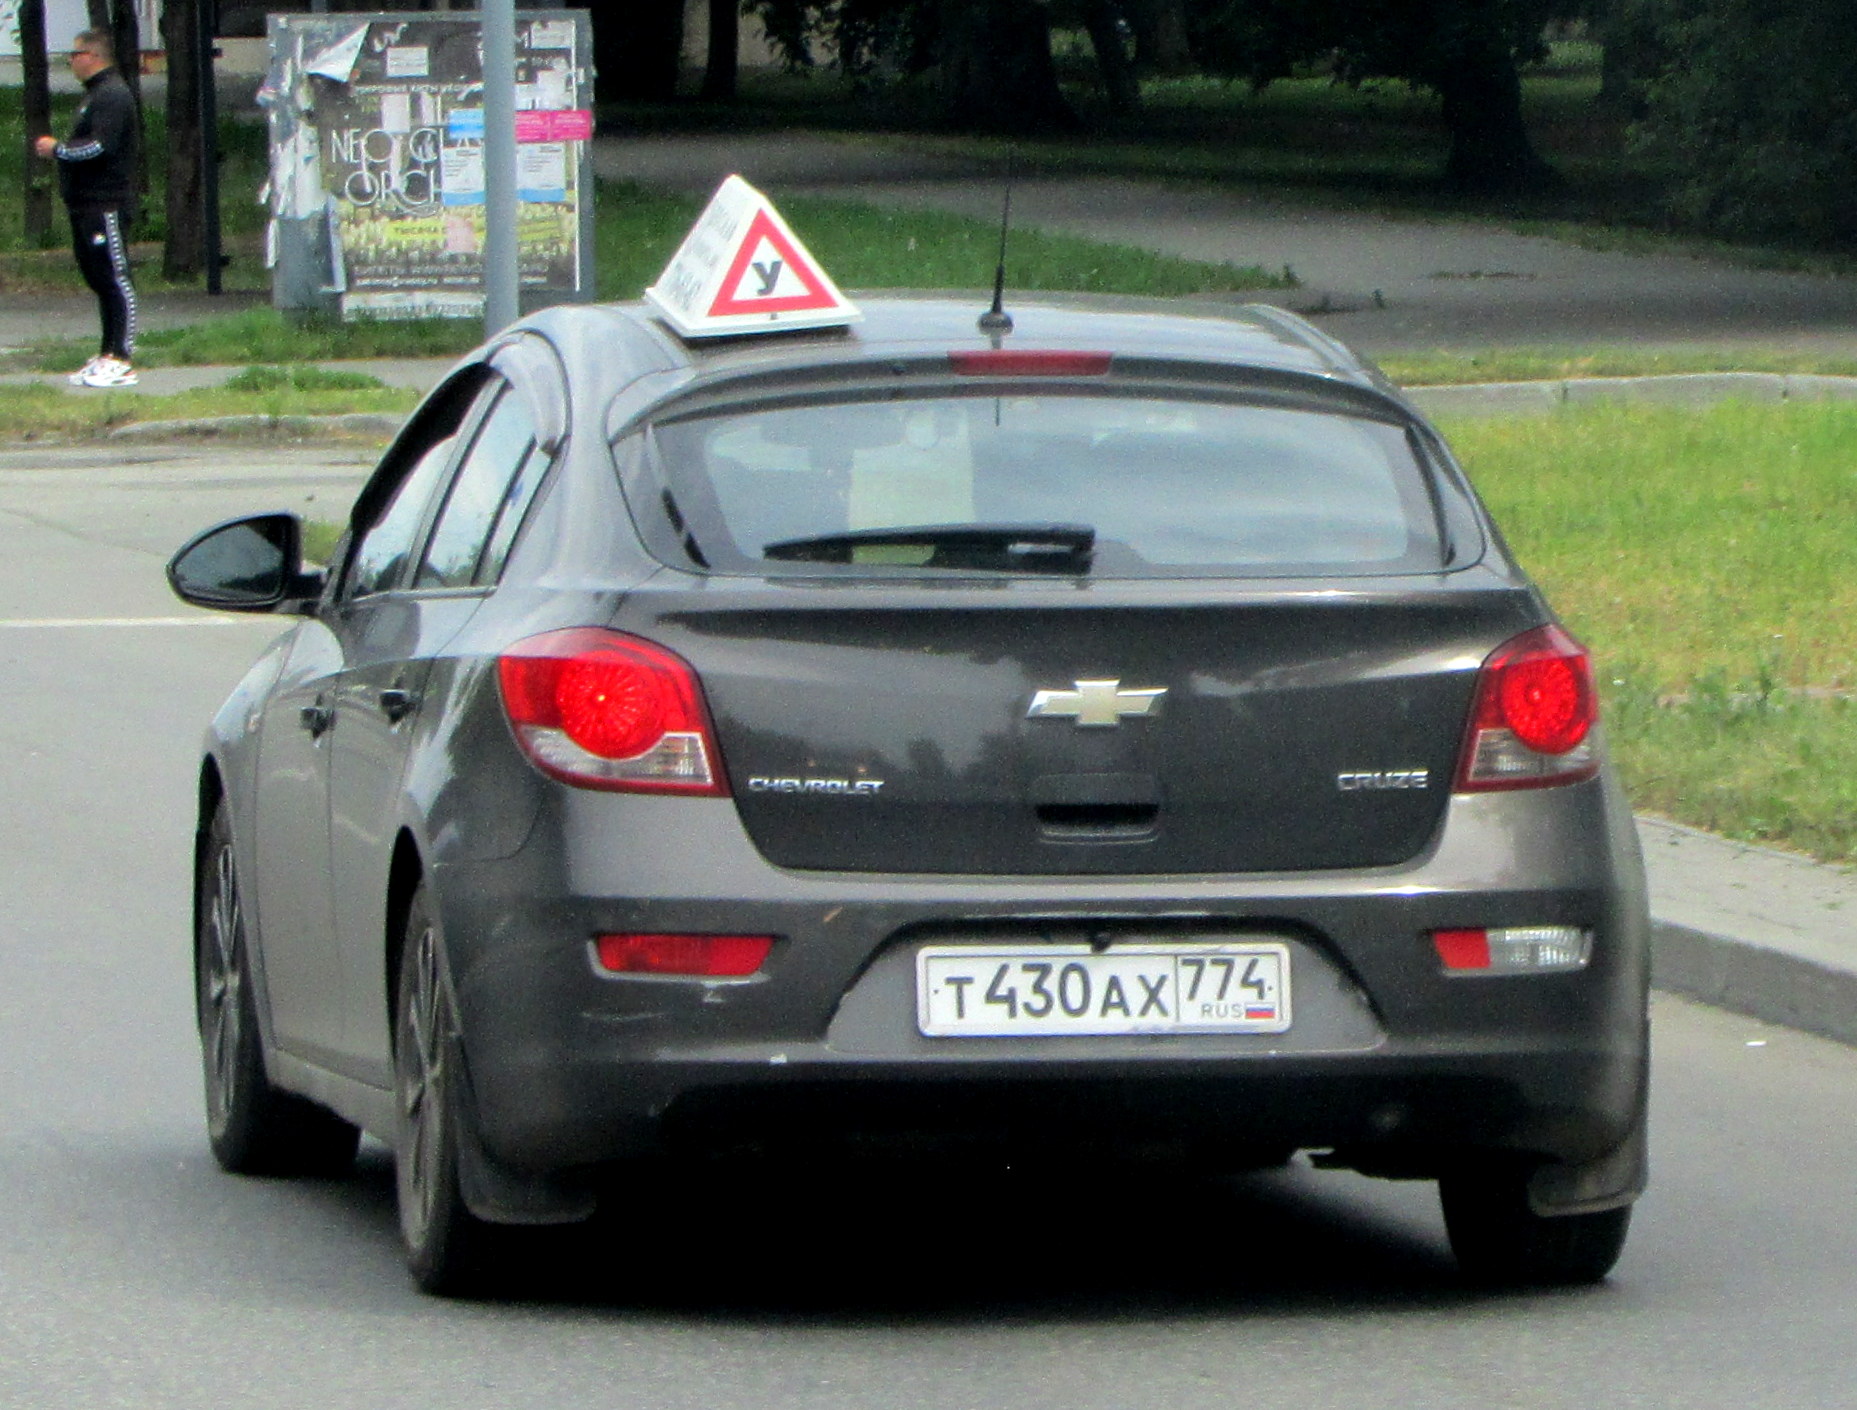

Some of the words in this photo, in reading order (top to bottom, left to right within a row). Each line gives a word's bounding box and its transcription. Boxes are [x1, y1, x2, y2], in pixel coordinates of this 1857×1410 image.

[331, 128, 394, 163] NEO
[752, 260, 783, 296] У
[748, 777, 885, 795] CHEVROLET
[1337, 769, 1429, 791] CRUZE
[1181, 957, 1264, 1001] 774
[1201, 1003, 1244, 1019] RUS
